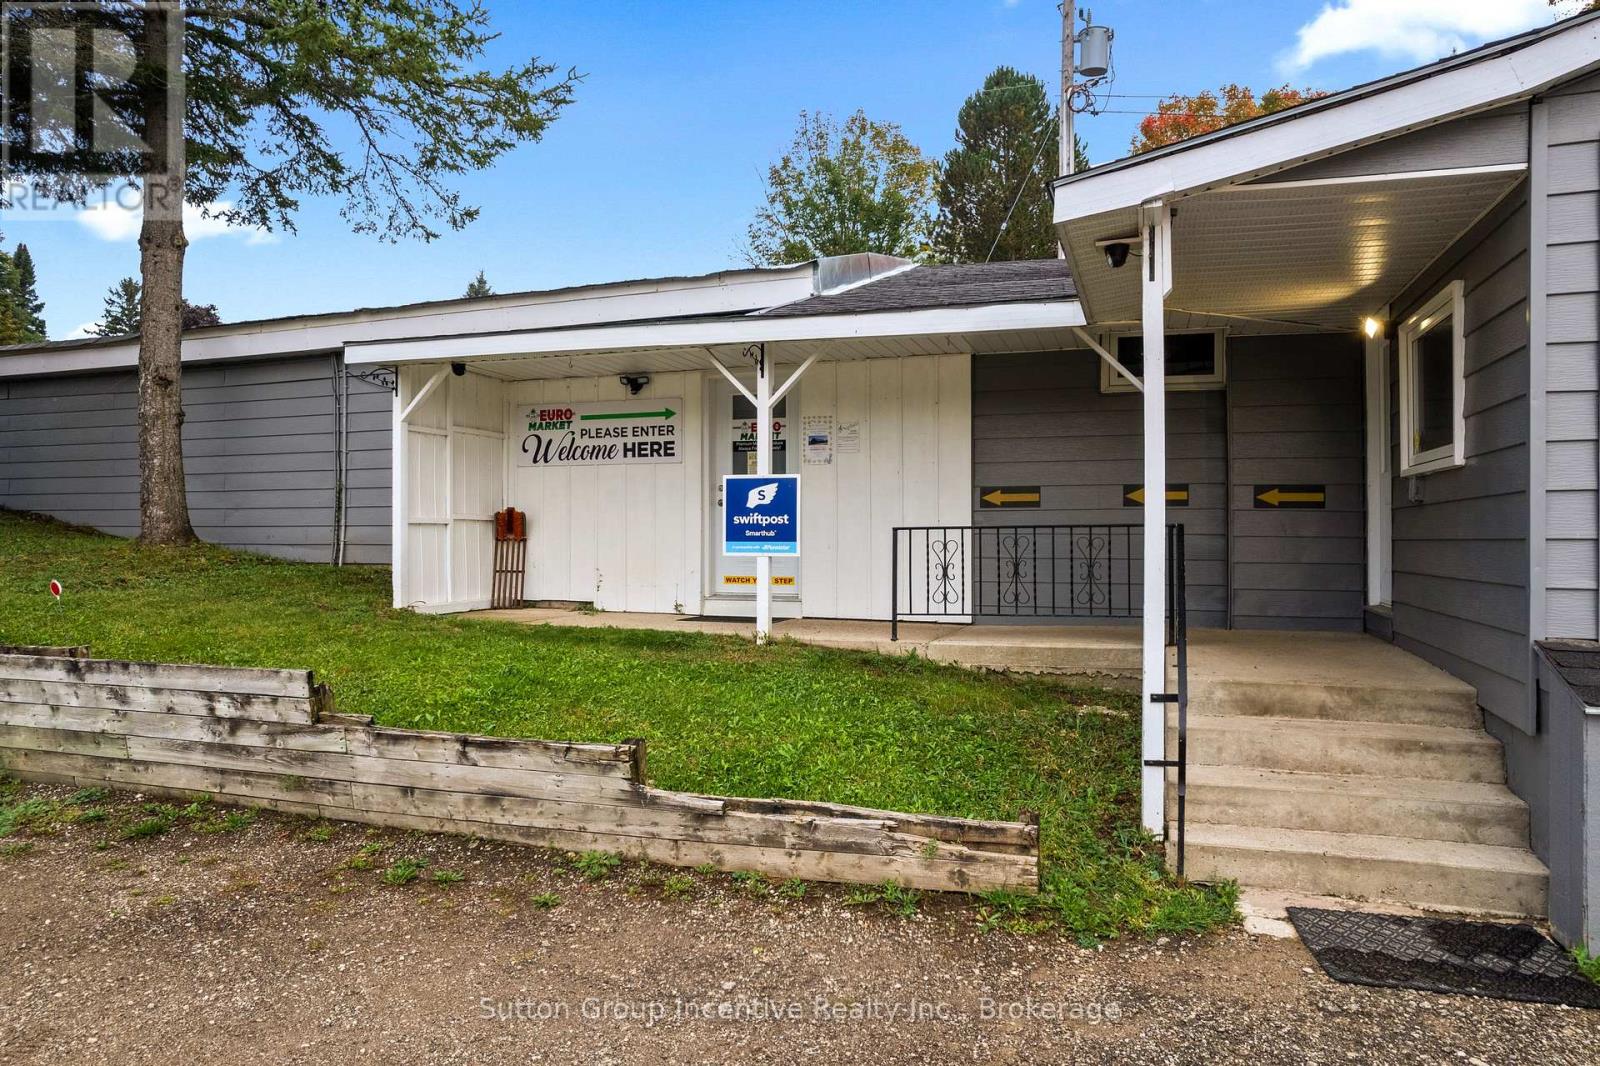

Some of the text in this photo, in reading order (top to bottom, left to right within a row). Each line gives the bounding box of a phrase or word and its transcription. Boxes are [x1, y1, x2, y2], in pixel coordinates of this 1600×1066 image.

[540, 408, 573, 421] EURO
[528, 420, 573, 431] MARKET
[580, 425, 675, 439] PLEASE ENTER
[522, 430, 675, 464] Welcome HERE
[758, 489, 766, 500] S
[733, 512, 789, 526] swiftpost
